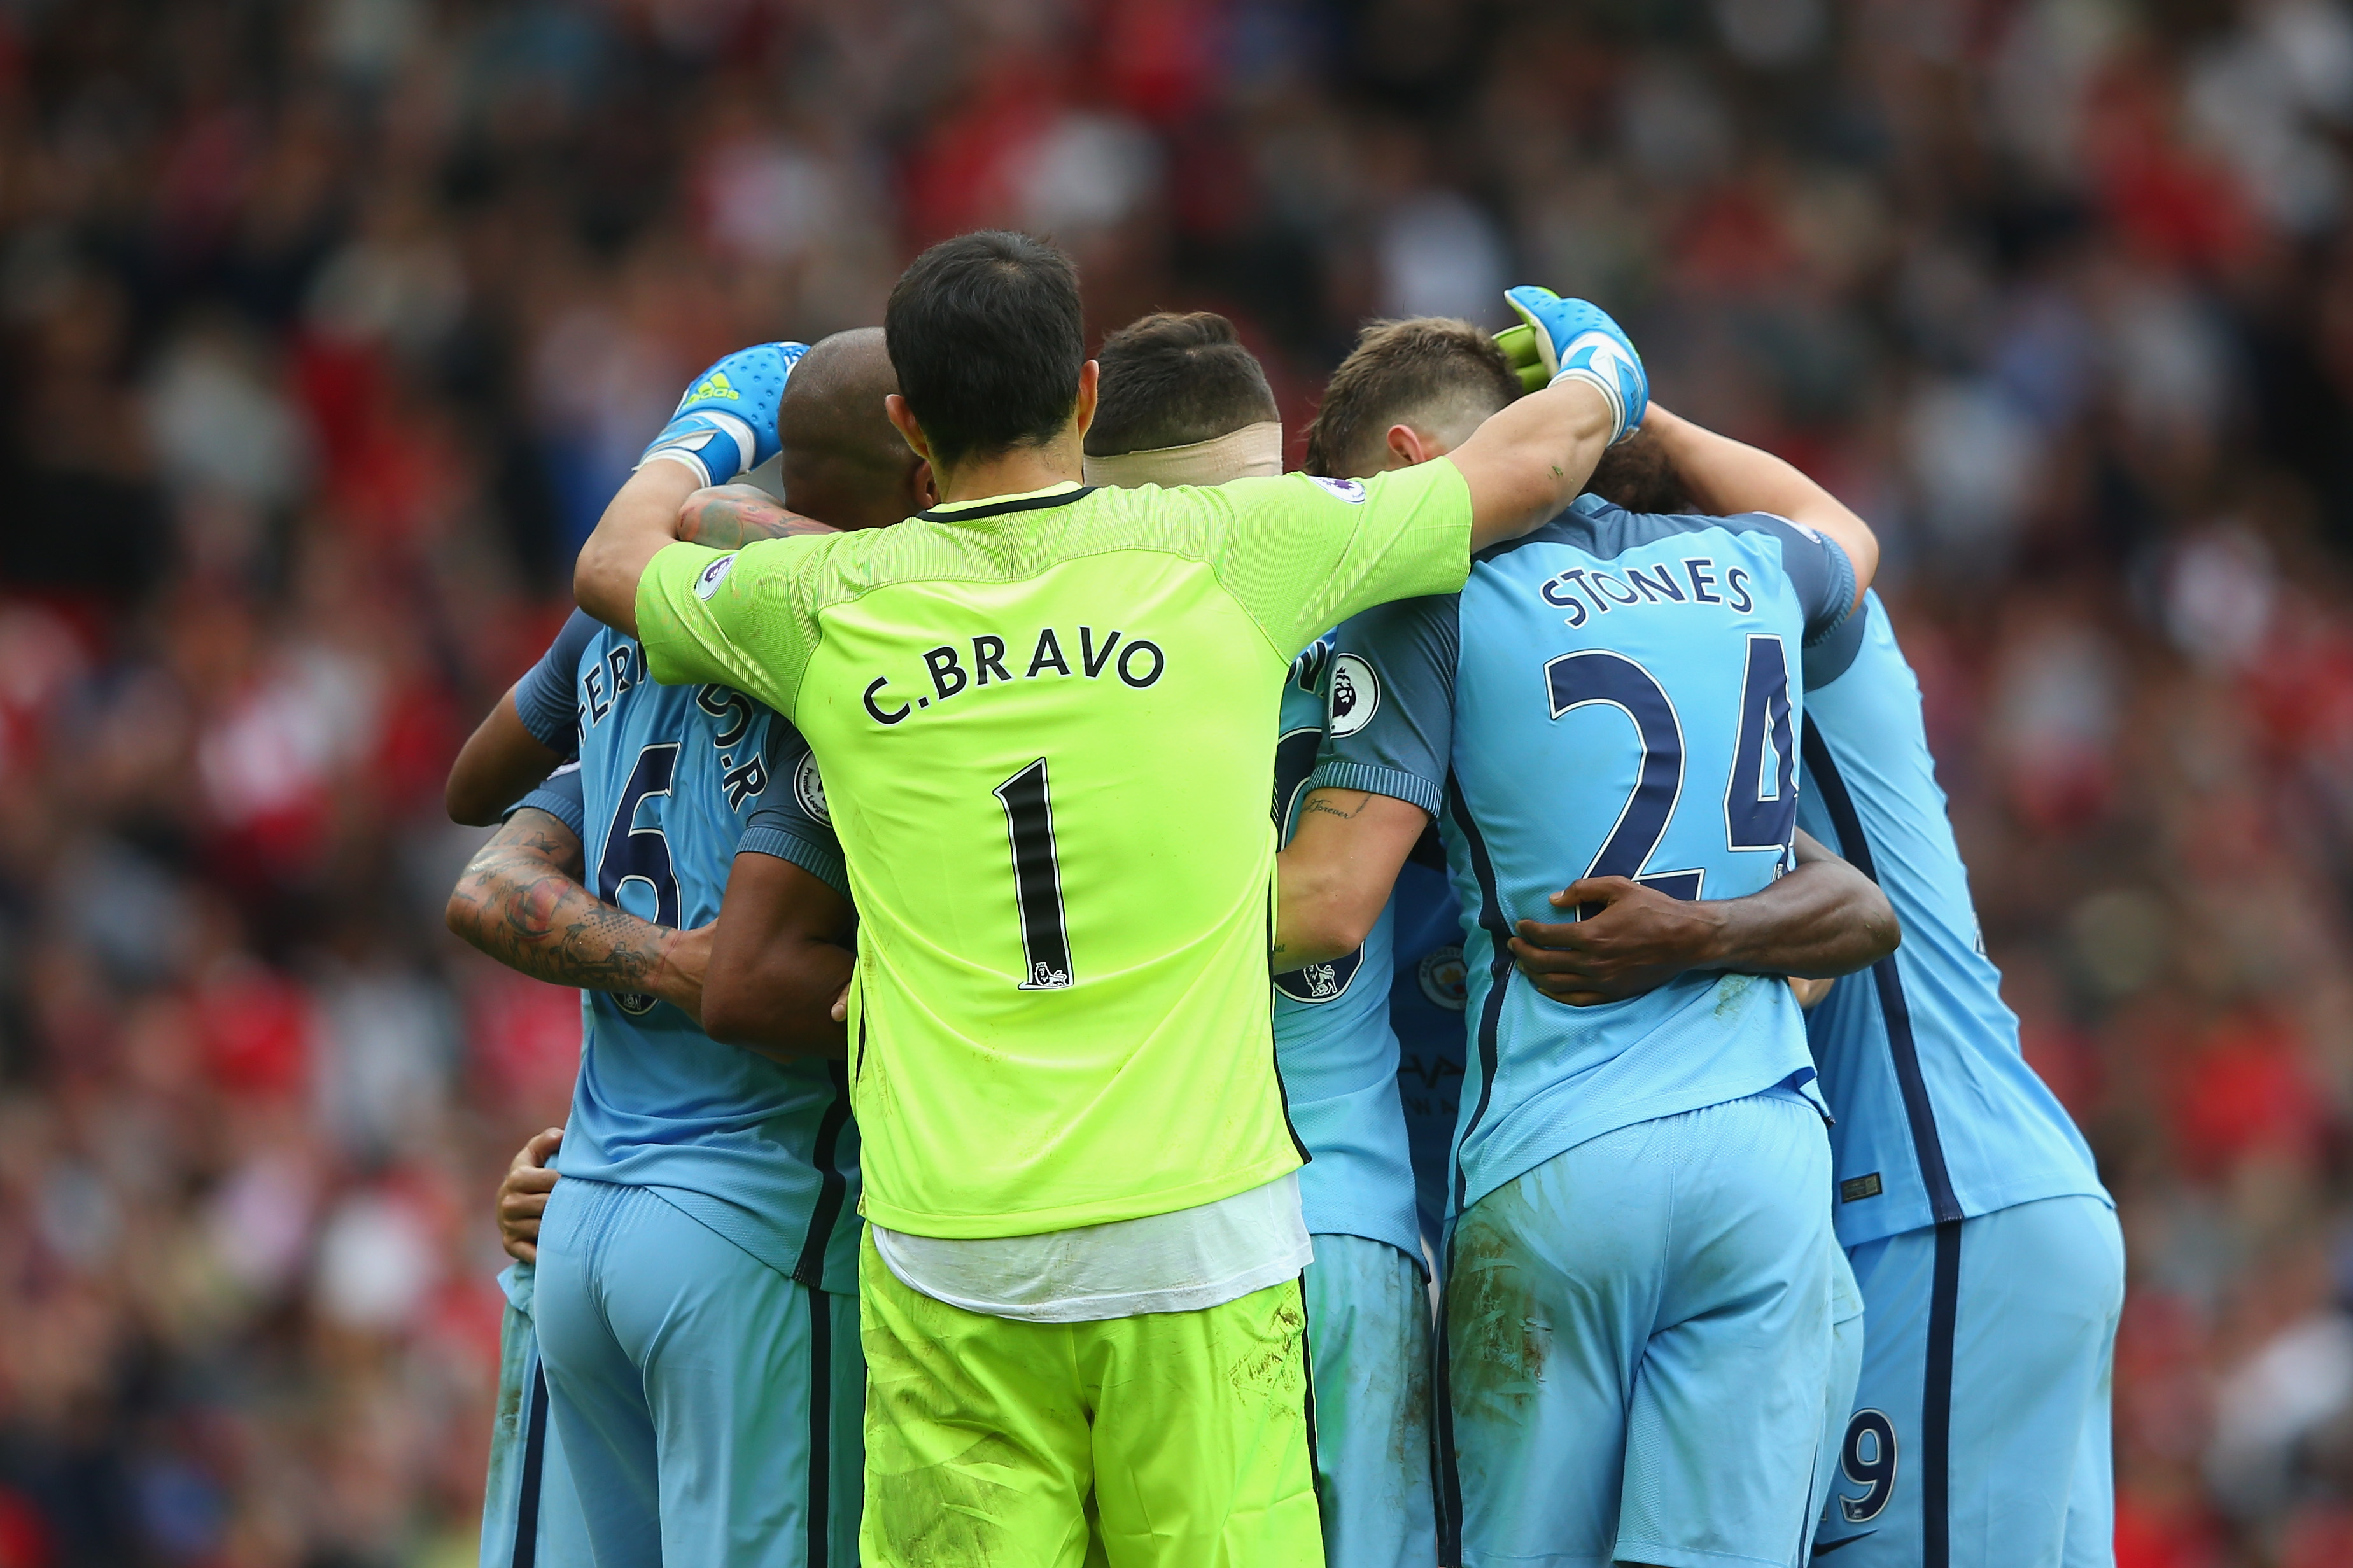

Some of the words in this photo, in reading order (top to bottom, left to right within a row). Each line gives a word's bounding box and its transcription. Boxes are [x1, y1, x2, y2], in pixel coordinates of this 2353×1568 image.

[863, 626, 1165, 725] C.BRAVO
[1540, 557, 1754, 629] STONES
[803, 767, 813, 795] Premier
[1543, 633, 1799, 924] 24
[598, 741, 682, 1015] 6
[992, 756, 1074, 991] 1
